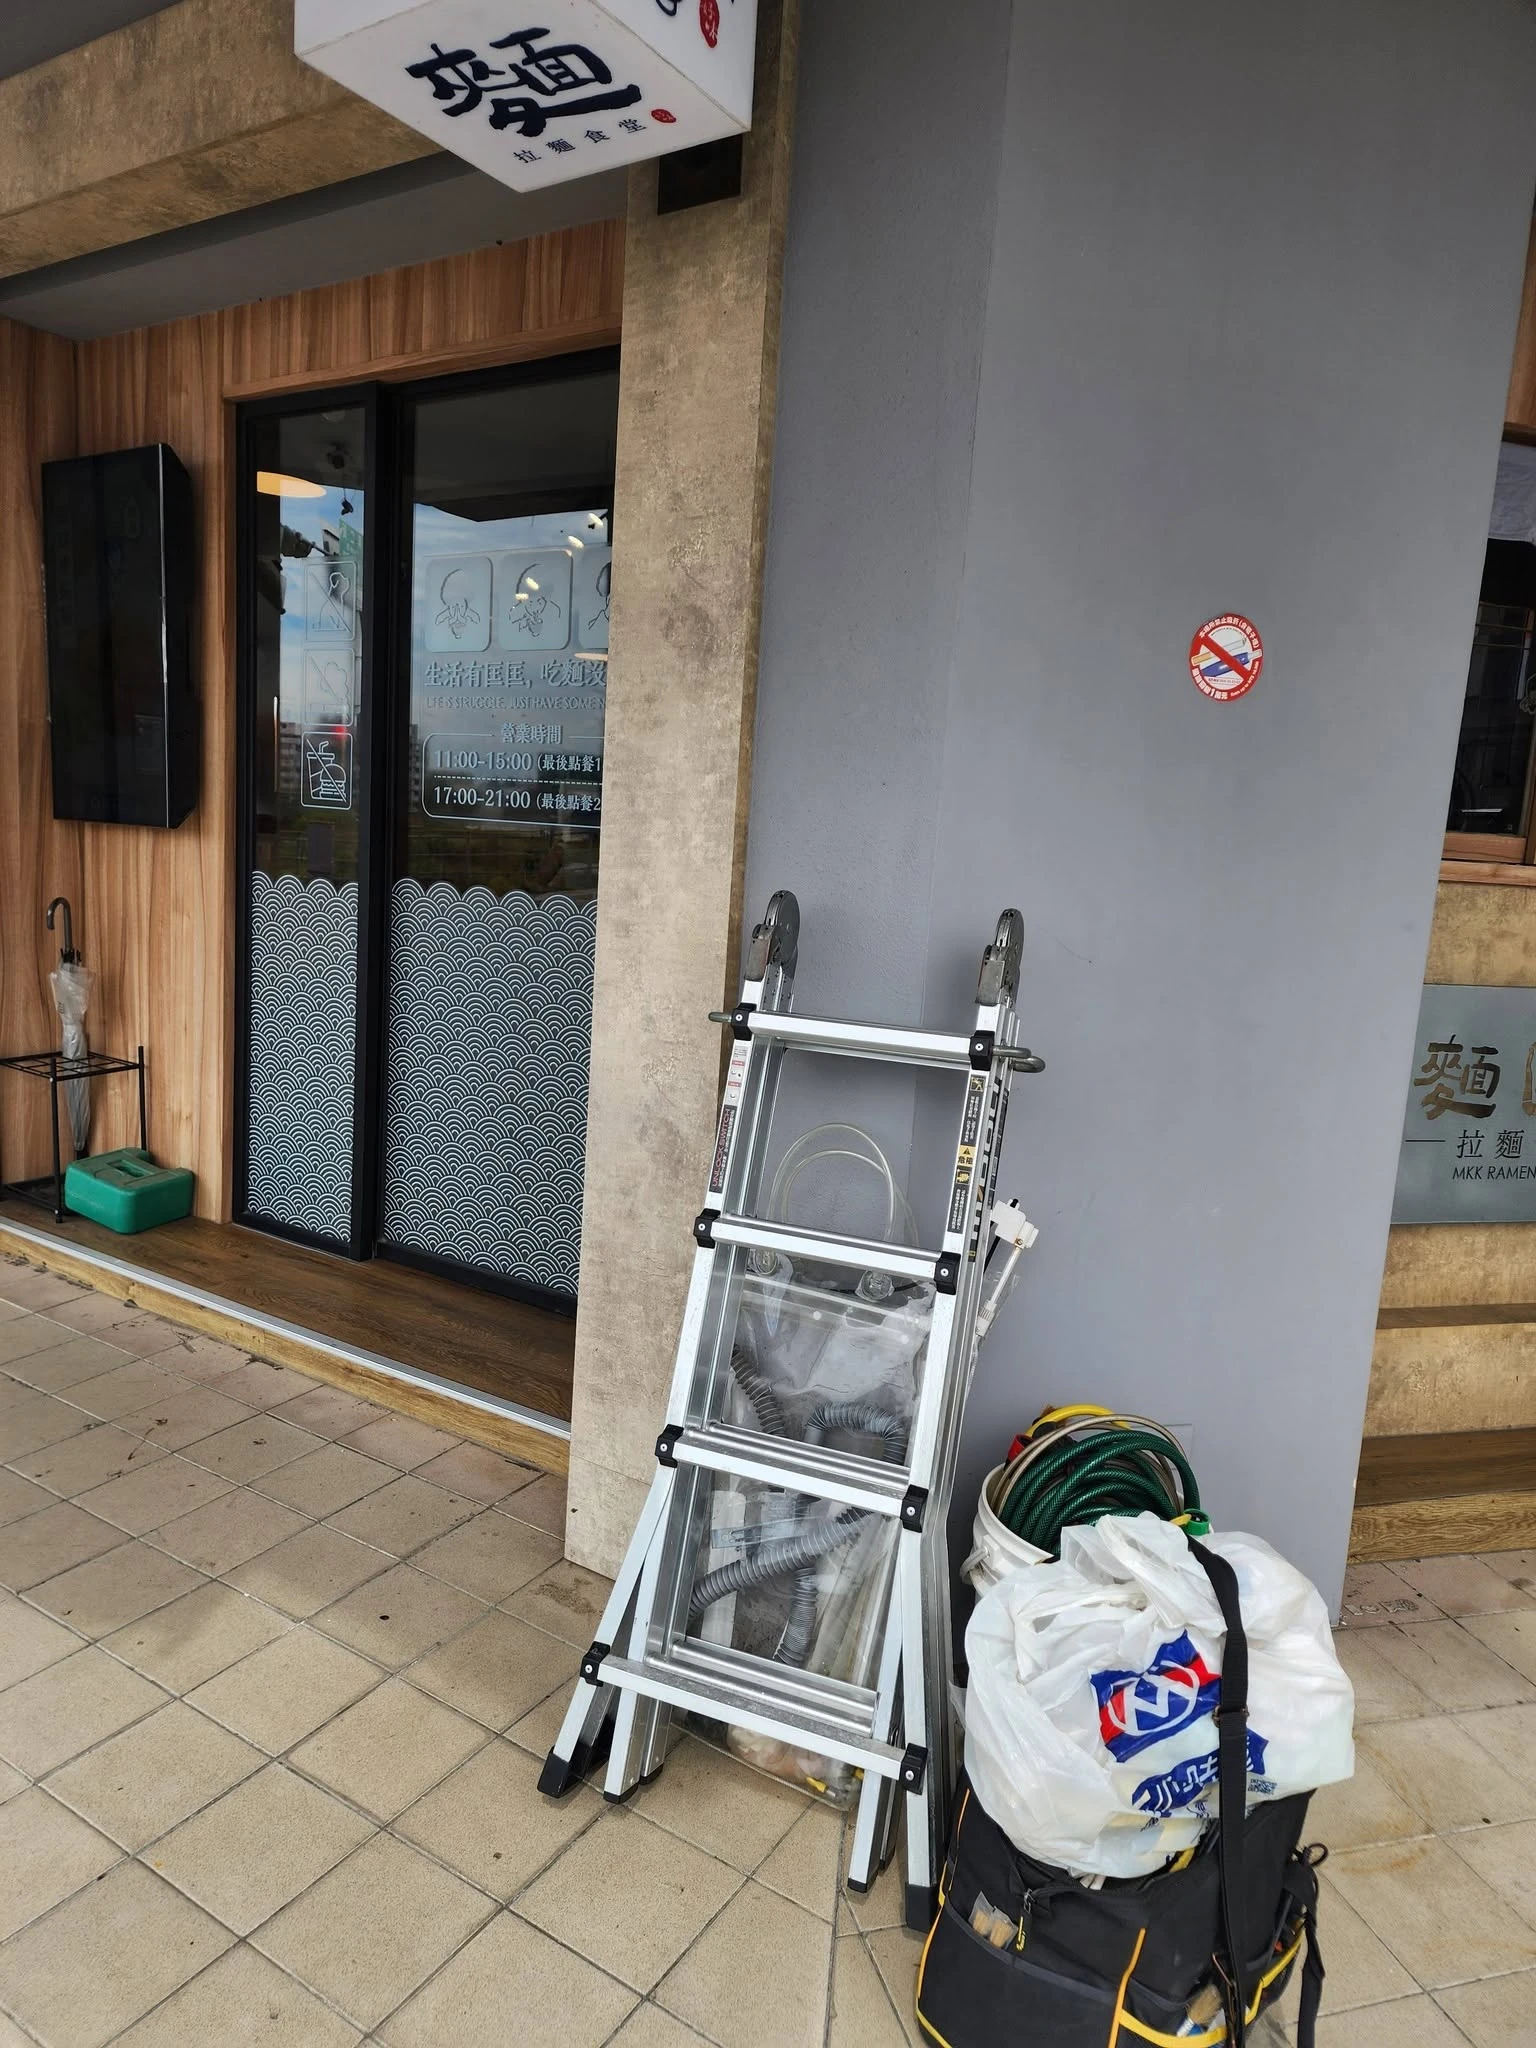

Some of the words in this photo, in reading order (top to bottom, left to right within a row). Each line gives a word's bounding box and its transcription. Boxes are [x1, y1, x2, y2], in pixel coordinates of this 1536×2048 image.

[405, 27, 642, 138] 麵
[513, 118, 647, 164] 拉麵食堂
[501, 722, 563, 744] 營業時間
[434, 750, 532, 771] 11:00-15:00
[434, 786, 531, 809] 17:00-21:00
[1413, 1034, 1536, 1121] 麵
[719, 1108, 730, 1147] SWITCH
[1456, 1129, 1525, 1159] 拉麵
[1452, 1165, 1484, 1180] MKK
[1487, 1165, 1536, 1180] RAMEN
